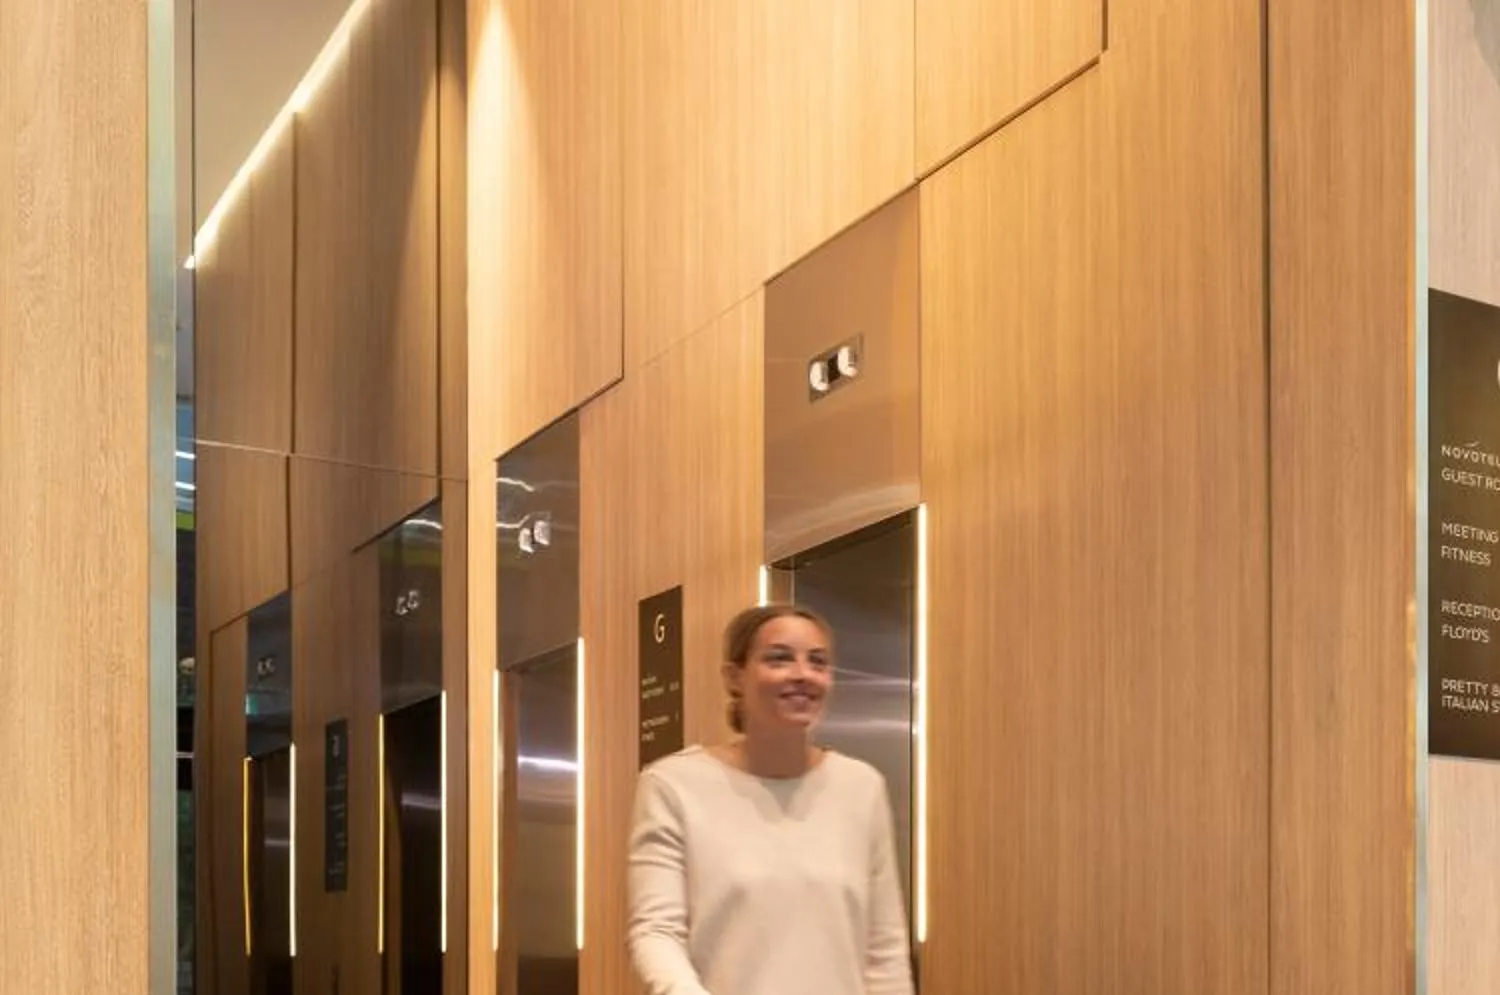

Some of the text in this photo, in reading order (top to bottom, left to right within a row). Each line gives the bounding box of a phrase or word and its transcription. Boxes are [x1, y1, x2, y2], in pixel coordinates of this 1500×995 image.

[1441, 467, 1482, 488] GUEST
[1441, 522, 1499, 544] MEETING
[1441, 545, 1491, 567] FITNESS
[654, 613, 665, 643] G
[1441, 624, 1490, 643] FLOYD'S
[1441, 678, 1489, 696] PRETTY
[1441, 695, 1489, 713] ITALIAN
